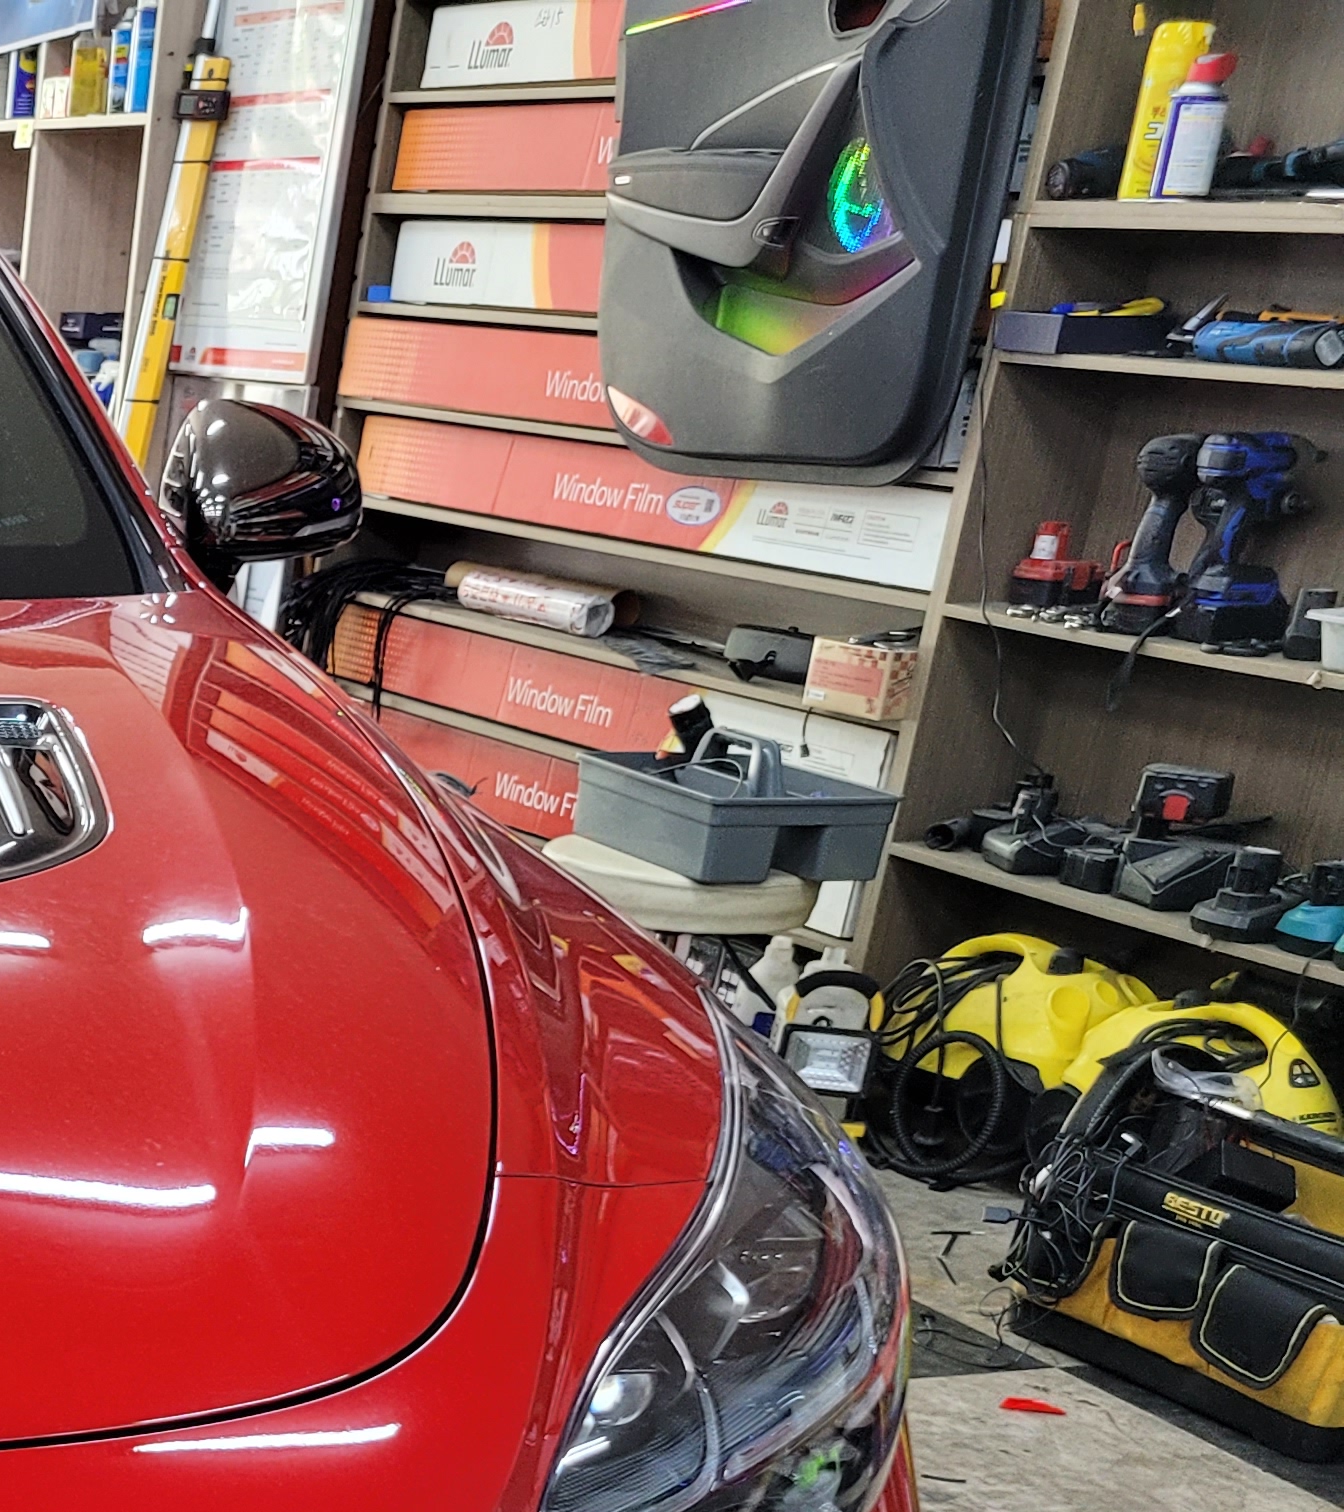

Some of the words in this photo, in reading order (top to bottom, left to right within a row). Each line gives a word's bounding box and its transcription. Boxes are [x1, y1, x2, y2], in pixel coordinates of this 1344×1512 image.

[468, 40, 513, 70] LLumar
[433, 257, 476, 288] LLumar
[553, 472, 623, 509] Window
[623, 483, 664, 515] Film
[507, 676, 574, 717] Window
[573, 693, 613, 728] Film
[495, 771, 560, 814] Window
[559, 791, 579, 821] Fi
